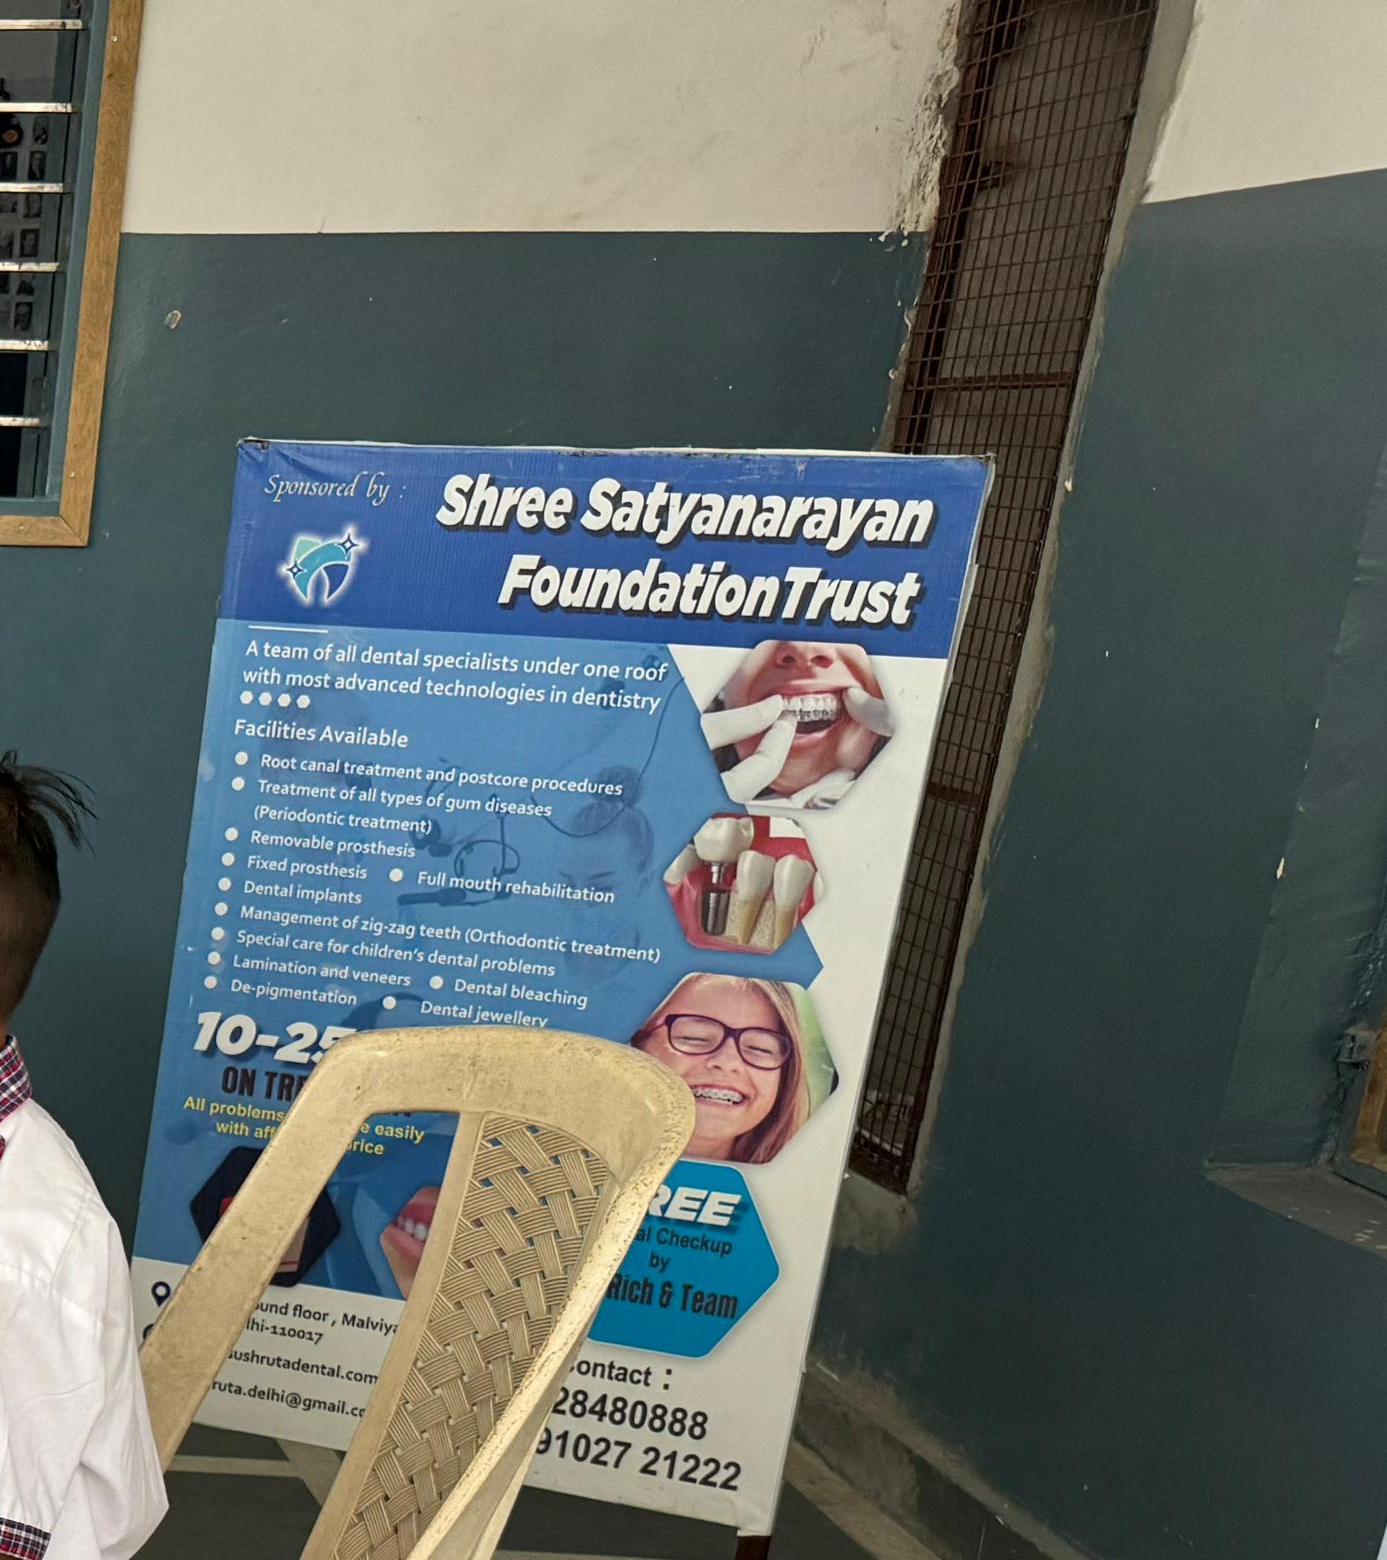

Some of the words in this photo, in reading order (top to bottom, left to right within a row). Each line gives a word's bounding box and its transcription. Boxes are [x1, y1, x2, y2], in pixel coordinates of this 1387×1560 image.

[265, 471, 365, 503] Sponsored
[366, 471, 391, 507] by
[436, 474, 576, 530] Shree
[580, 478, 935, 553] Satyanarayan
[245, 640, 259, 656] A
[263, 642, 308, 660] team
[313, 644, 333, 660] of
[335, 645, 357, 662] all
[360, 646, 420, 666] dental
[422, 651, 519, 673] specialists
[523, 657, 580, 676] under
[583, 662, 620, 678] one
[624, 663, 669, 681] roof
[242, 667, 281, 686] with
[285, 673, 331, 689] most
[334, 673, 422, 694] advanced
[425, 679, 546, 706] technologies
[549, 685, 567, 703] in
[571, 687, 662, 715] dentistry
[234, 719, 316, 741] Facilities
[318, 725, 409, 748] Available
[260, 754, 297, 770] Root
[299, 759, 340, 774] canal
[343, 762, 422, 780] treatment
[425, 768, 456, 782] and
[458, 772, 528, 788] postcore
[531, 777, 624, 797] procedures
[258, 780, 336, 799] Treatment
[339, 786, 356, 800] of
[358, 788, 377, 802] all
[380, 791, 423, 808] types
[426, 793, 444, 807] of
[445, 799, 481, 813] gum
[484, 798, 553, 817] diseases
[253, 805, 345, 827] (Periodontic
[348, 814, 433, 836] treatment)
[250, 830, 334, 851] Removable
[336, 841, 417, 859] prosthesis
[247, 855, 288, 872] Fixed
[290, 862, 368, 880] prosthesis
[243, 880, 293, 898] Dental
[296, 884, 363, 905] implants
[417, 871, 445, 887] Full
[449, 876, 502, 893] mouth
[506, 881, 616, 904] rehabilitation
[239, 905, 339, 929] Management
[341, 915, 360, 930] of
[360, 917, 417, 940] zig-zag
[419, 924, 462, 941] teeth
[464, 928, 568, 953] (Orthodontic
[570, 940, 661, 964] treatment)
[236, 930, 288, 948] Special
[291, 937, 323, 952] care
[327, 939, 350, 954] for
[427, 949, 478, 968] dental
[480, 958, 556, 977] problems
[232, 955, 317, 977] Lamination
[319, 966, 350, 980] and
[352, 973, 412, 987] veneers
[230, 979, 358, 1006] De-pigmentation
[454, 979, 507, 997] Dental
[510, 985, 588, 1010] bleaching
[420, 1000, 473, 1019] Dental
[474, 1006, 549, 1028] jewellery
[221, 1066, 256, 1097] ON
[183, 1096, 206, 1112] All
[209, 1101, 285, 1122] problems
[374, 1125, 426, 1145] easily
[215, 1121, 249, 1137] with
[648, 1183, 743, 1228] REE
[656, 1227, 733, 1259] Checkup
[649, 1250, 671, 1274] by
[292, 1304, 329, 1323] floor
[658, 1280, 675, 1309] &
[680, 1283, 739, 1320] Team
[245, 1316, 324, 1346] lhi-110017
[570, 1359, 652, 1387] ontact
[552, 1386, 709, 1441] 28480888
[639, 1446, 742, 1492] 21222
